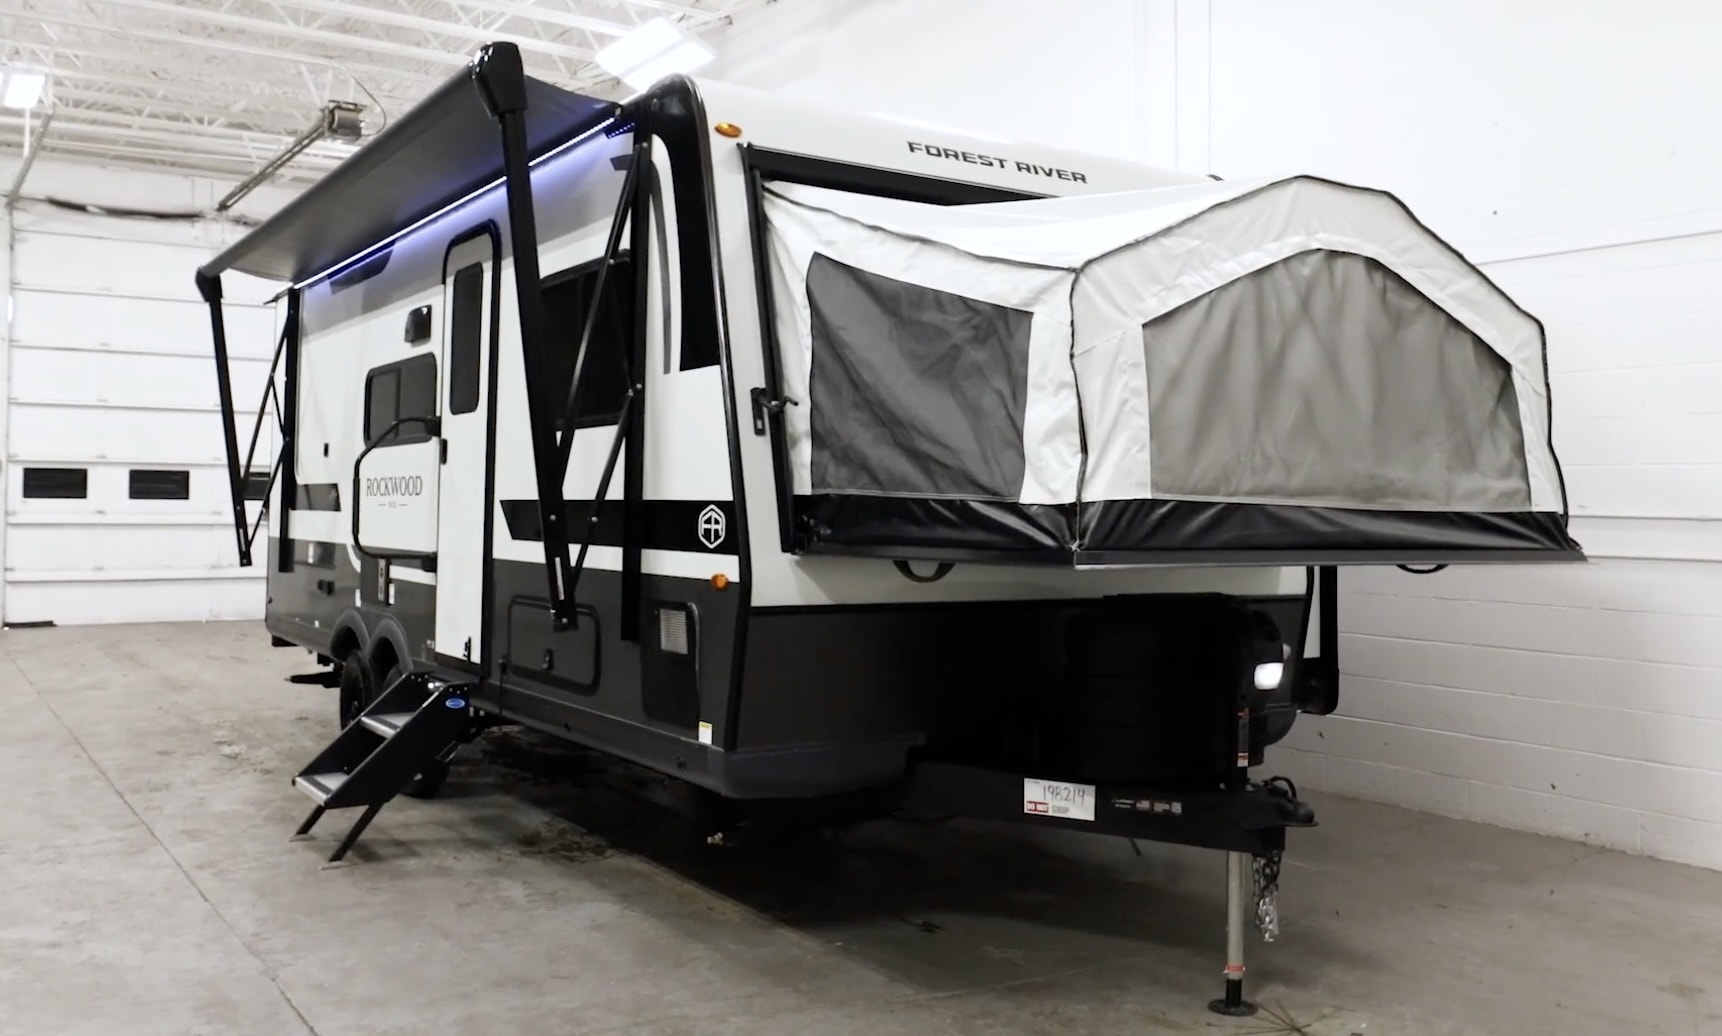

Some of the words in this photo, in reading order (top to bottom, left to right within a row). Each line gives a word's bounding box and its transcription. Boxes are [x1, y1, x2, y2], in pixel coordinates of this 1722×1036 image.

[907, 141, 1007, 169] FOREST
[1015, 161, 1088, 184] RIVER
[366, 476, 423, 497] ROCKWOOD
[1043, 784, 1086, 806] 198214
